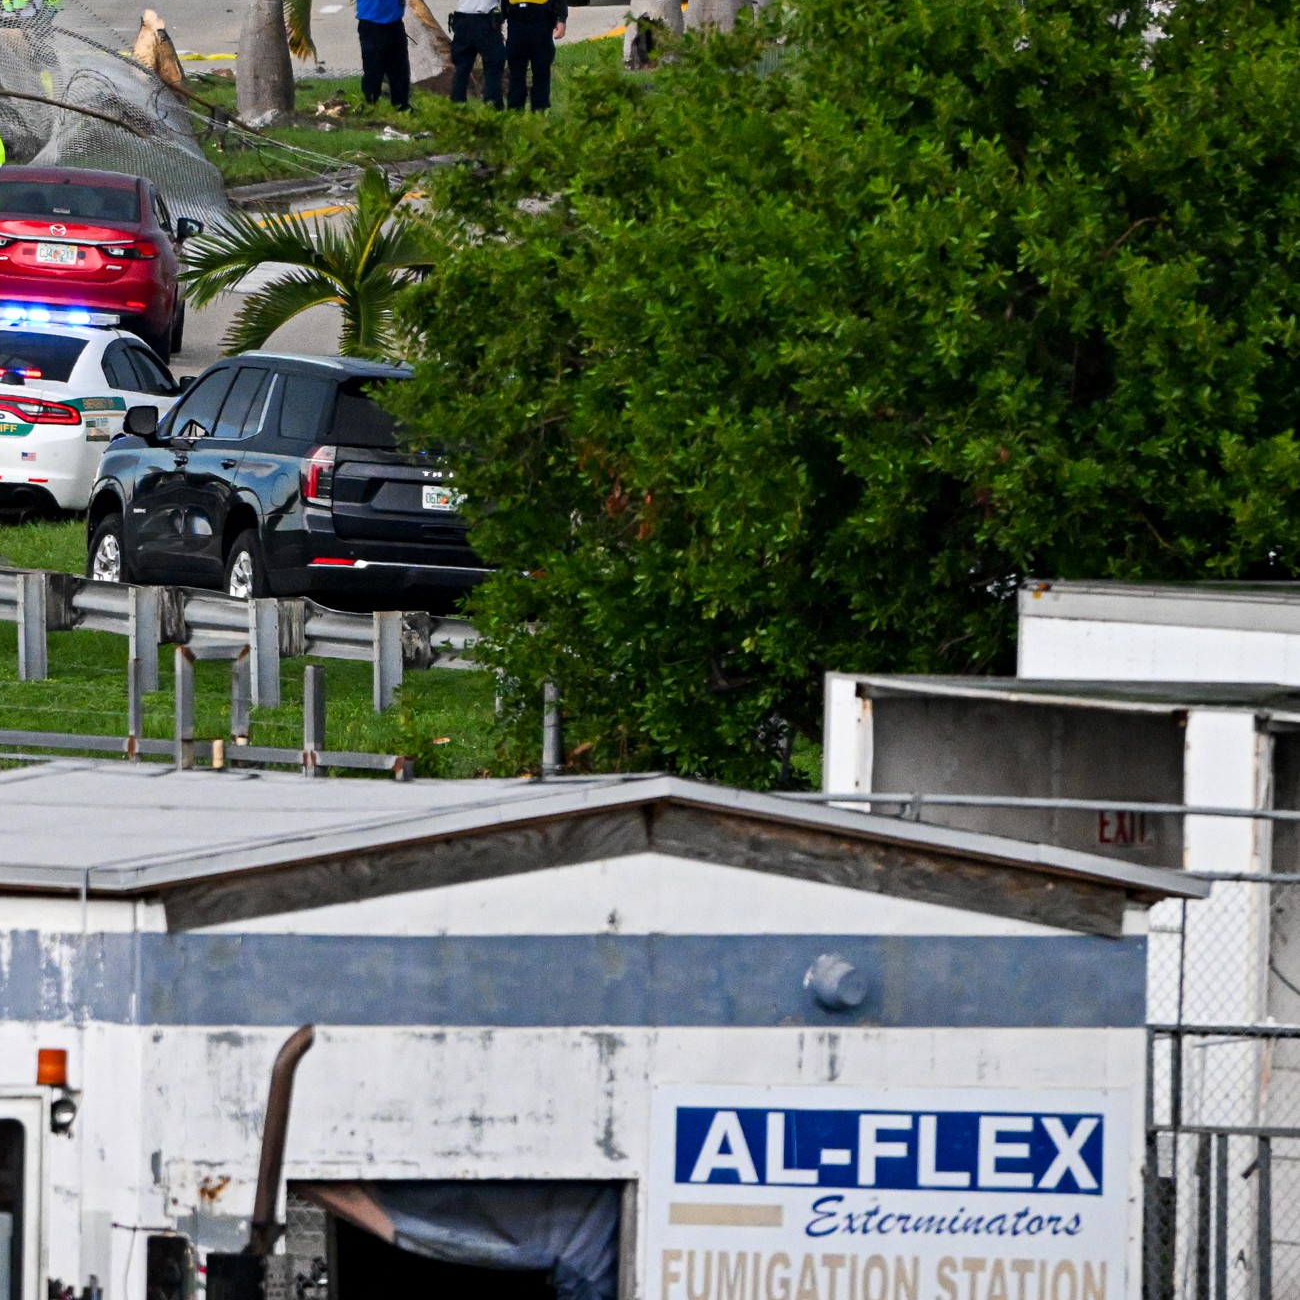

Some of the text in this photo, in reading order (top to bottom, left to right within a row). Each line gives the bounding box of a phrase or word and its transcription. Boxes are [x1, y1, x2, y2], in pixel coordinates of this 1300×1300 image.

[689, 1110, 1100, 1190] AL-FLEX
[805, 1195, 1085, 1238] Exterminators
[660, 1248, 1108, 1300] FUMIGATION STATION
